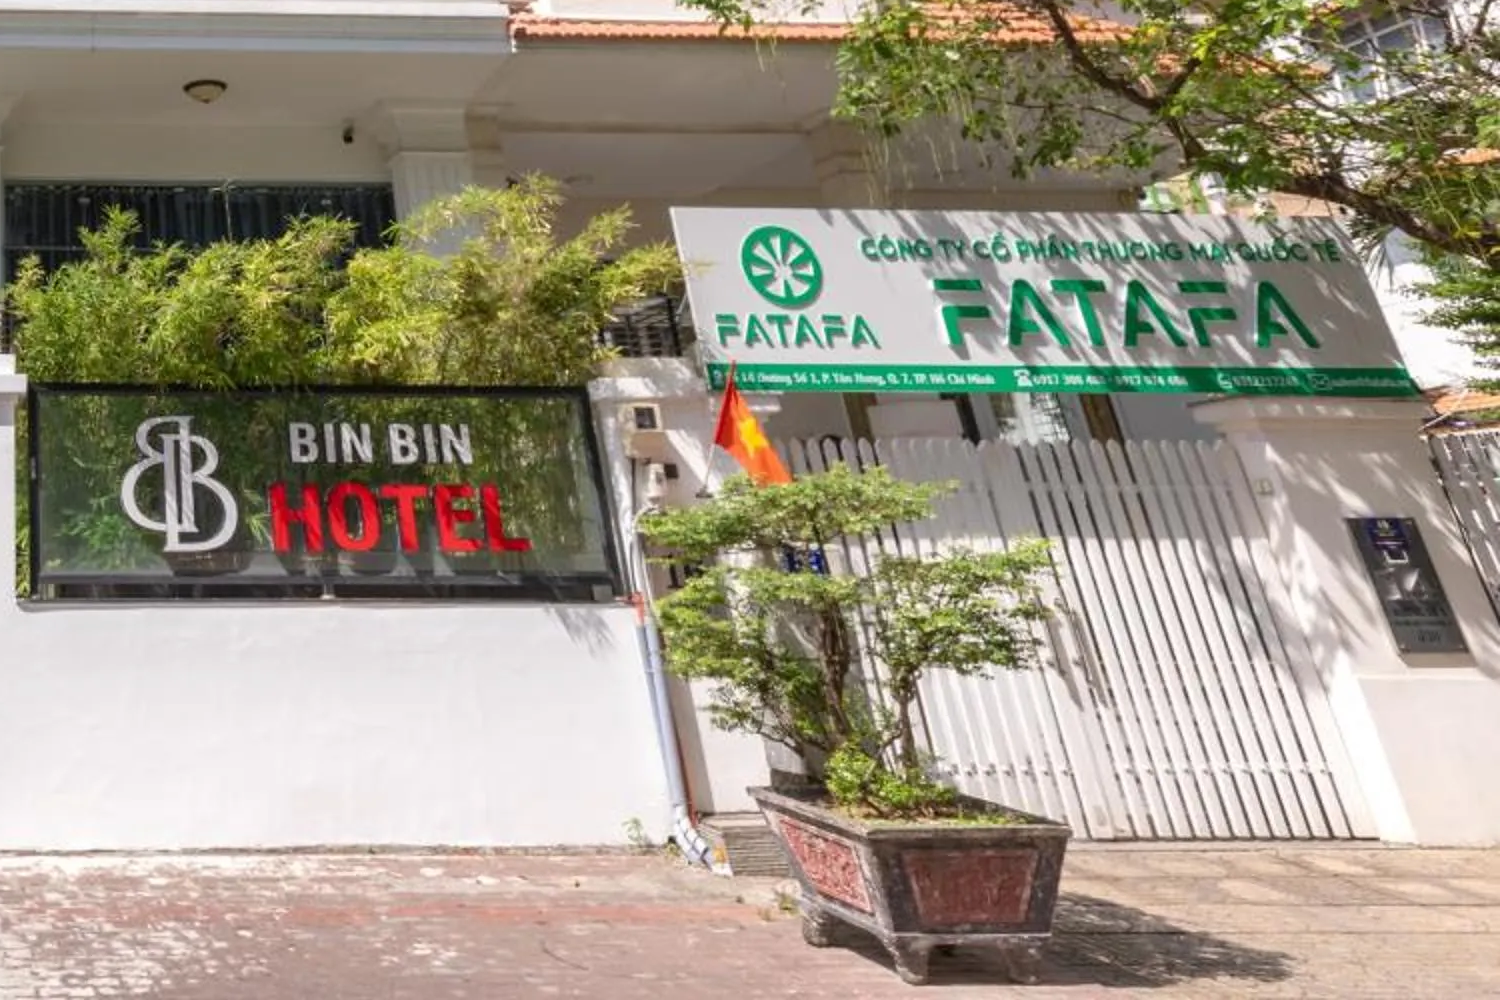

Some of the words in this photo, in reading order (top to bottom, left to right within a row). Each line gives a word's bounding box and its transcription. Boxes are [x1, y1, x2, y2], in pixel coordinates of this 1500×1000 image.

[861, 234, 933, 262] CÔNG
[937, 238, 967, 260] TY
[714, 312, 882, 350] FATAFA
[930, 278, 1322, 350] FATAFA
[288, 423, 374, 465] BIN
[387, 423, 474, 466] BIN
[267, 481, 533, 554] HOTEL
